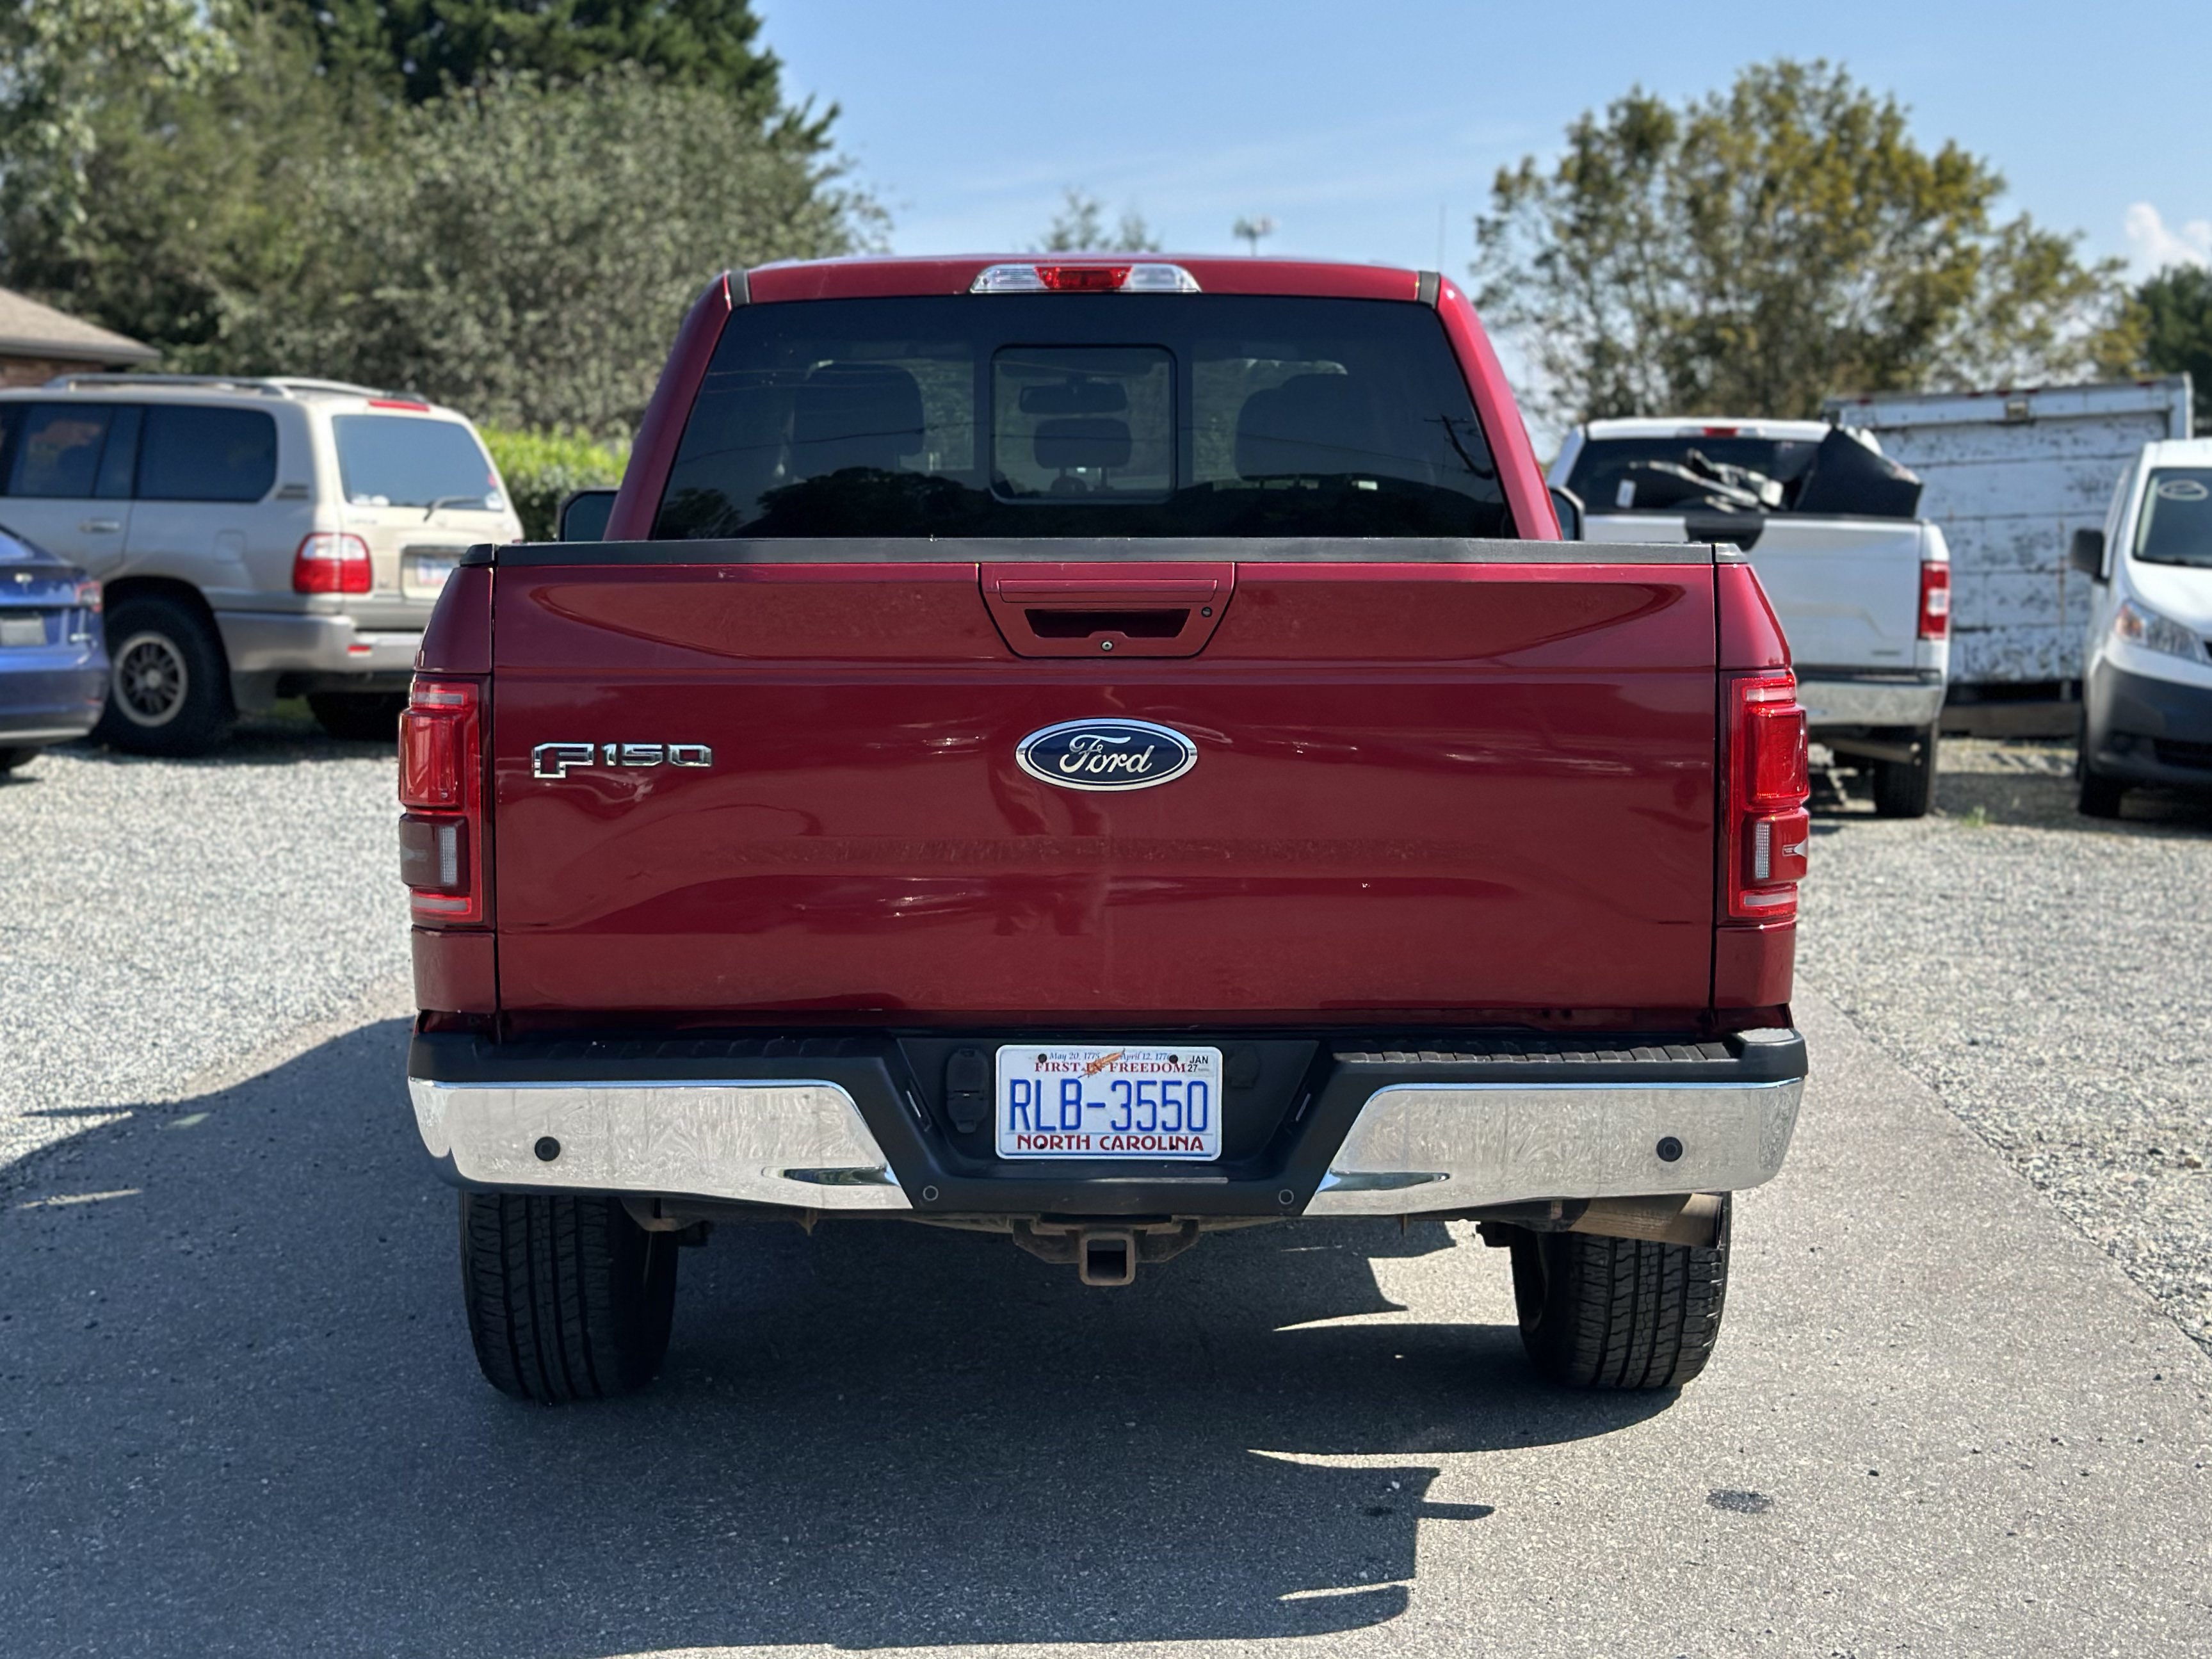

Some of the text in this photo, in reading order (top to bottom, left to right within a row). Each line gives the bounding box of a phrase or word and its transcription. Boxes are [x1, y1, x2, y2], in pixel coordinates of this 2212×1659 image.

[1059, 734, 1155, 773] Ford
[1049, 1052, 1067, 1061] May
[1120, 1051, 1142, 1061] April
[1189, 1056, 1209, 1064] JAN
[1035, 1062, 1080, 1072] FIRST
[1110, 1062, 1185, 1072] FREEDOM
[1010, 1078, 1209, 1132] RLB-3550
[1017, 1135, 1204, 1151] NORTH CAROLINA
